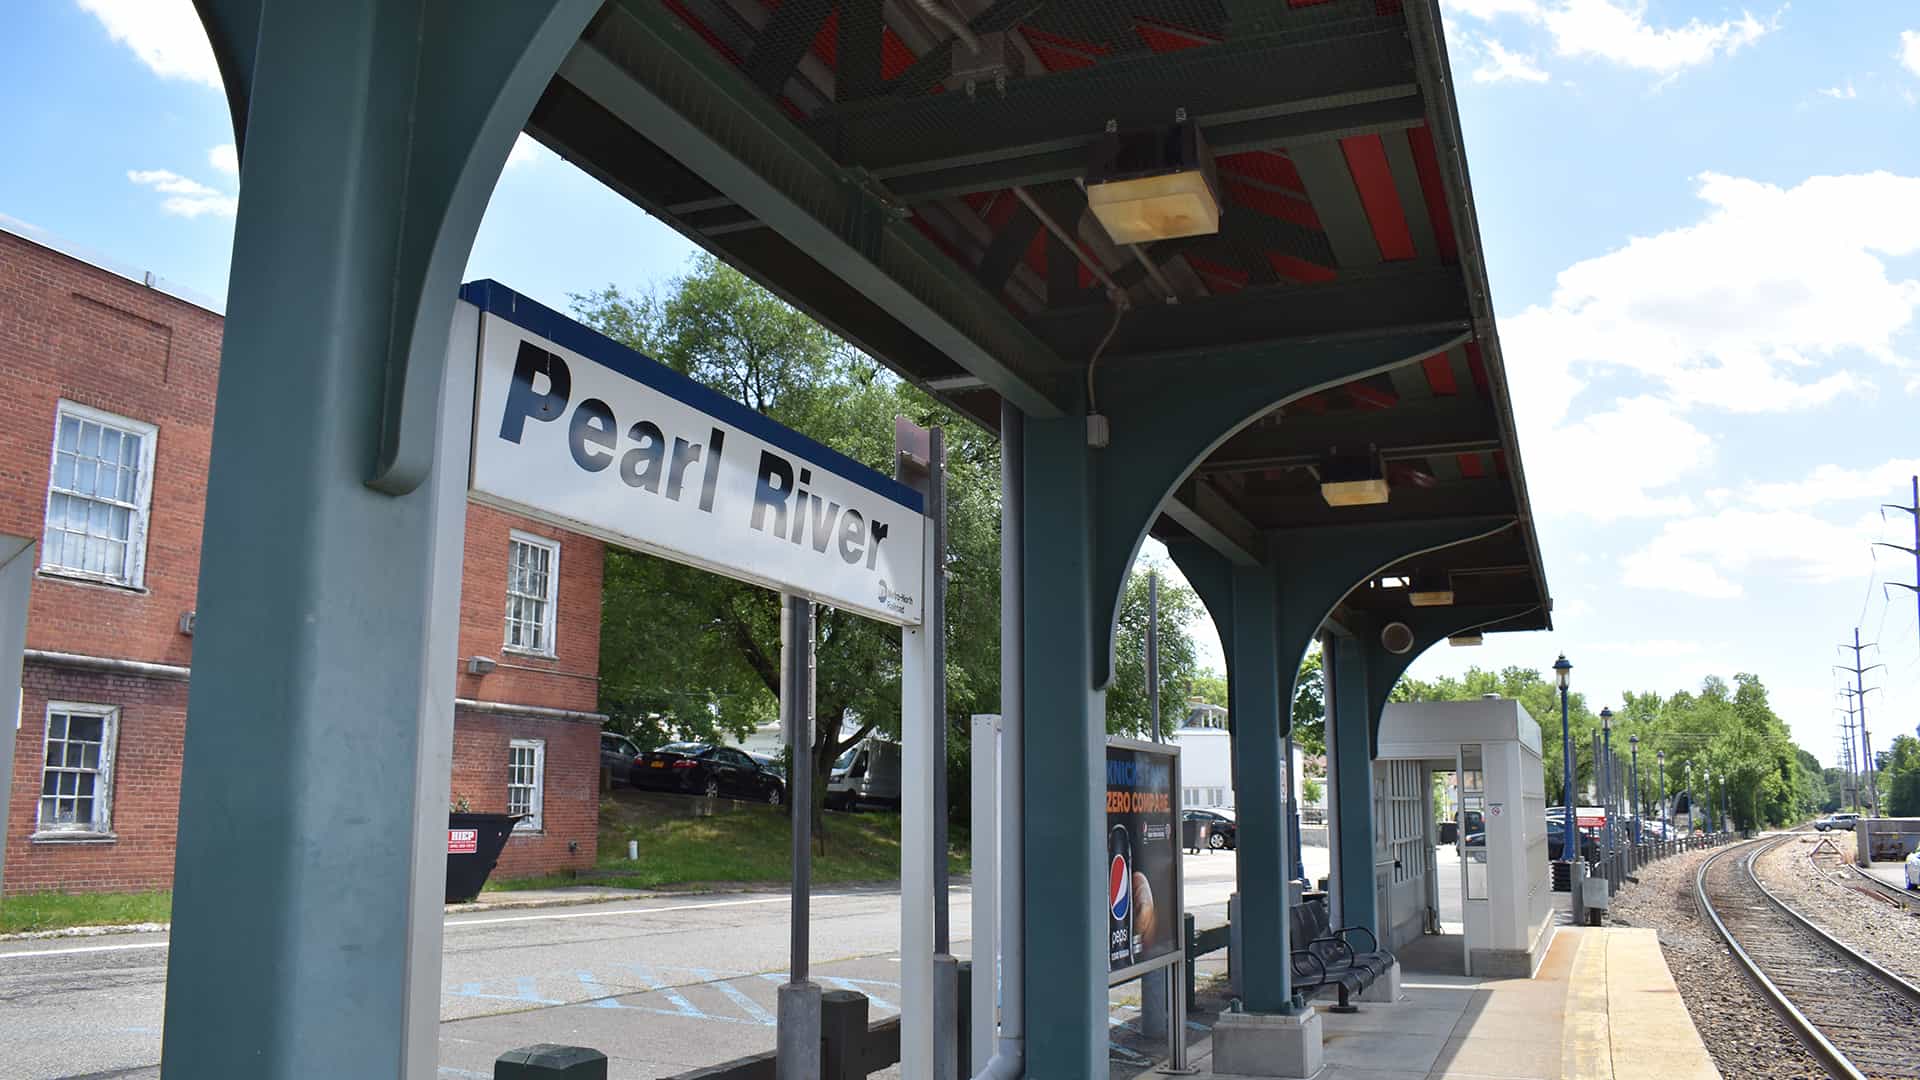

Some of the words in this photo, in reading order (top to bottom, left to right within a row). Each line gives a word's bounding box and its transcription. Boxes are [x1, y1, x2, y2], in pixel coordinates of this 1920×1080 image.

[499, 340, 725, 513] Pearl
[749, 449, 889, 570] River
[1106, 791, 1131, 814] ZERO
